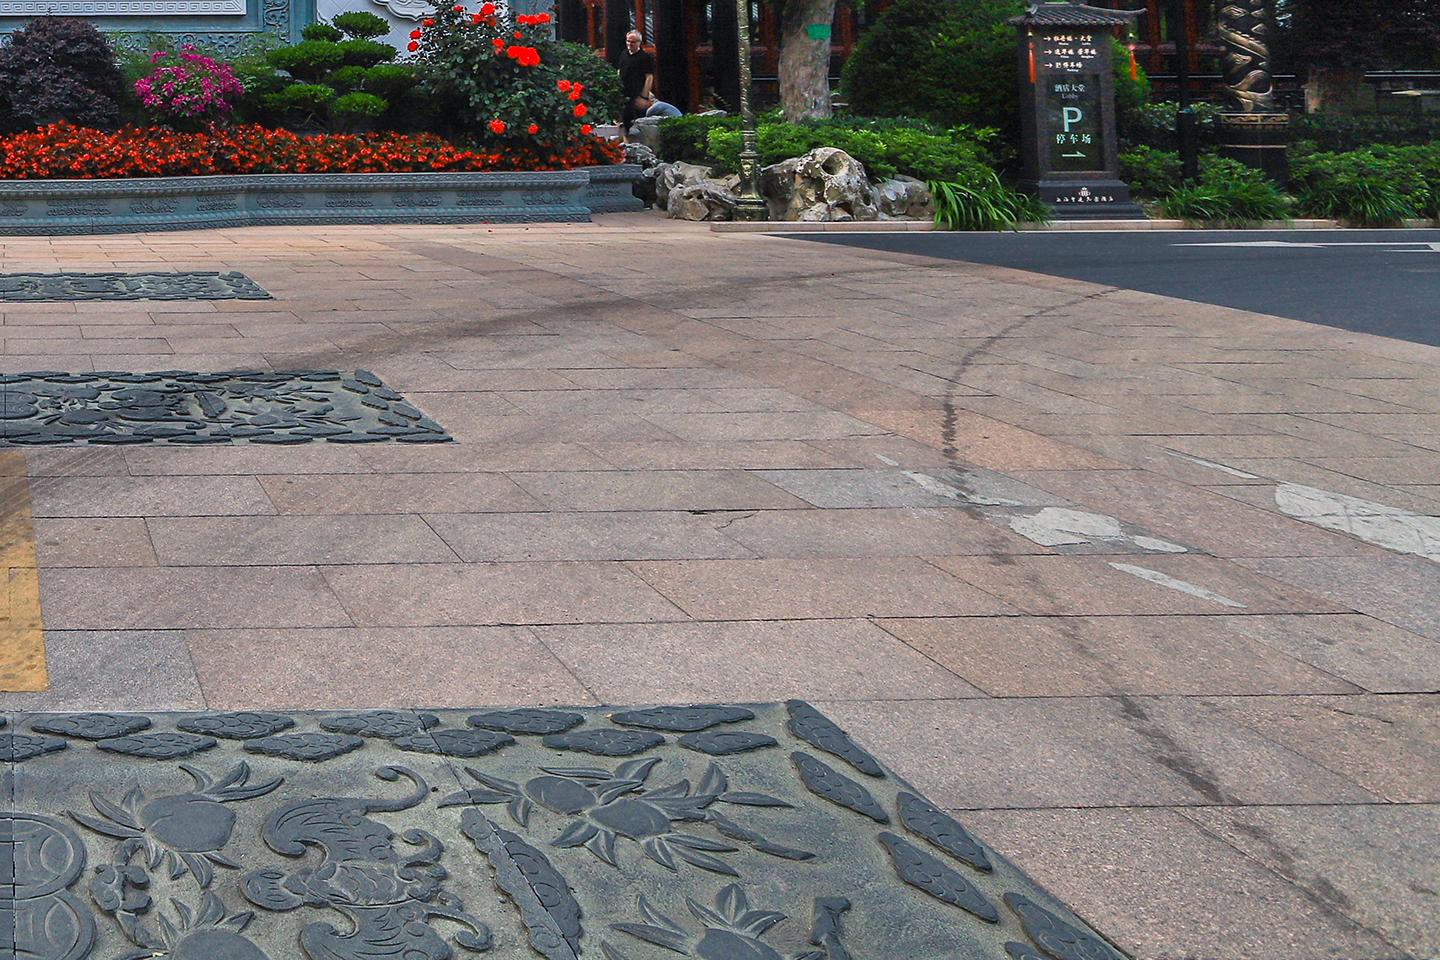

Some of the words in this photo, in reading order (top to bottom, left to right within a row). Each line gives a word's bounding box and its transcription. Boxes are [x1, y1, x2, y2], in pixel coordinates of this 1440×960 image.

[1054, 84, 1086, 92] 酒店大堂
[1062, 107, 1083, 132] P
[1056, 133, 1092, 144] 停车场
